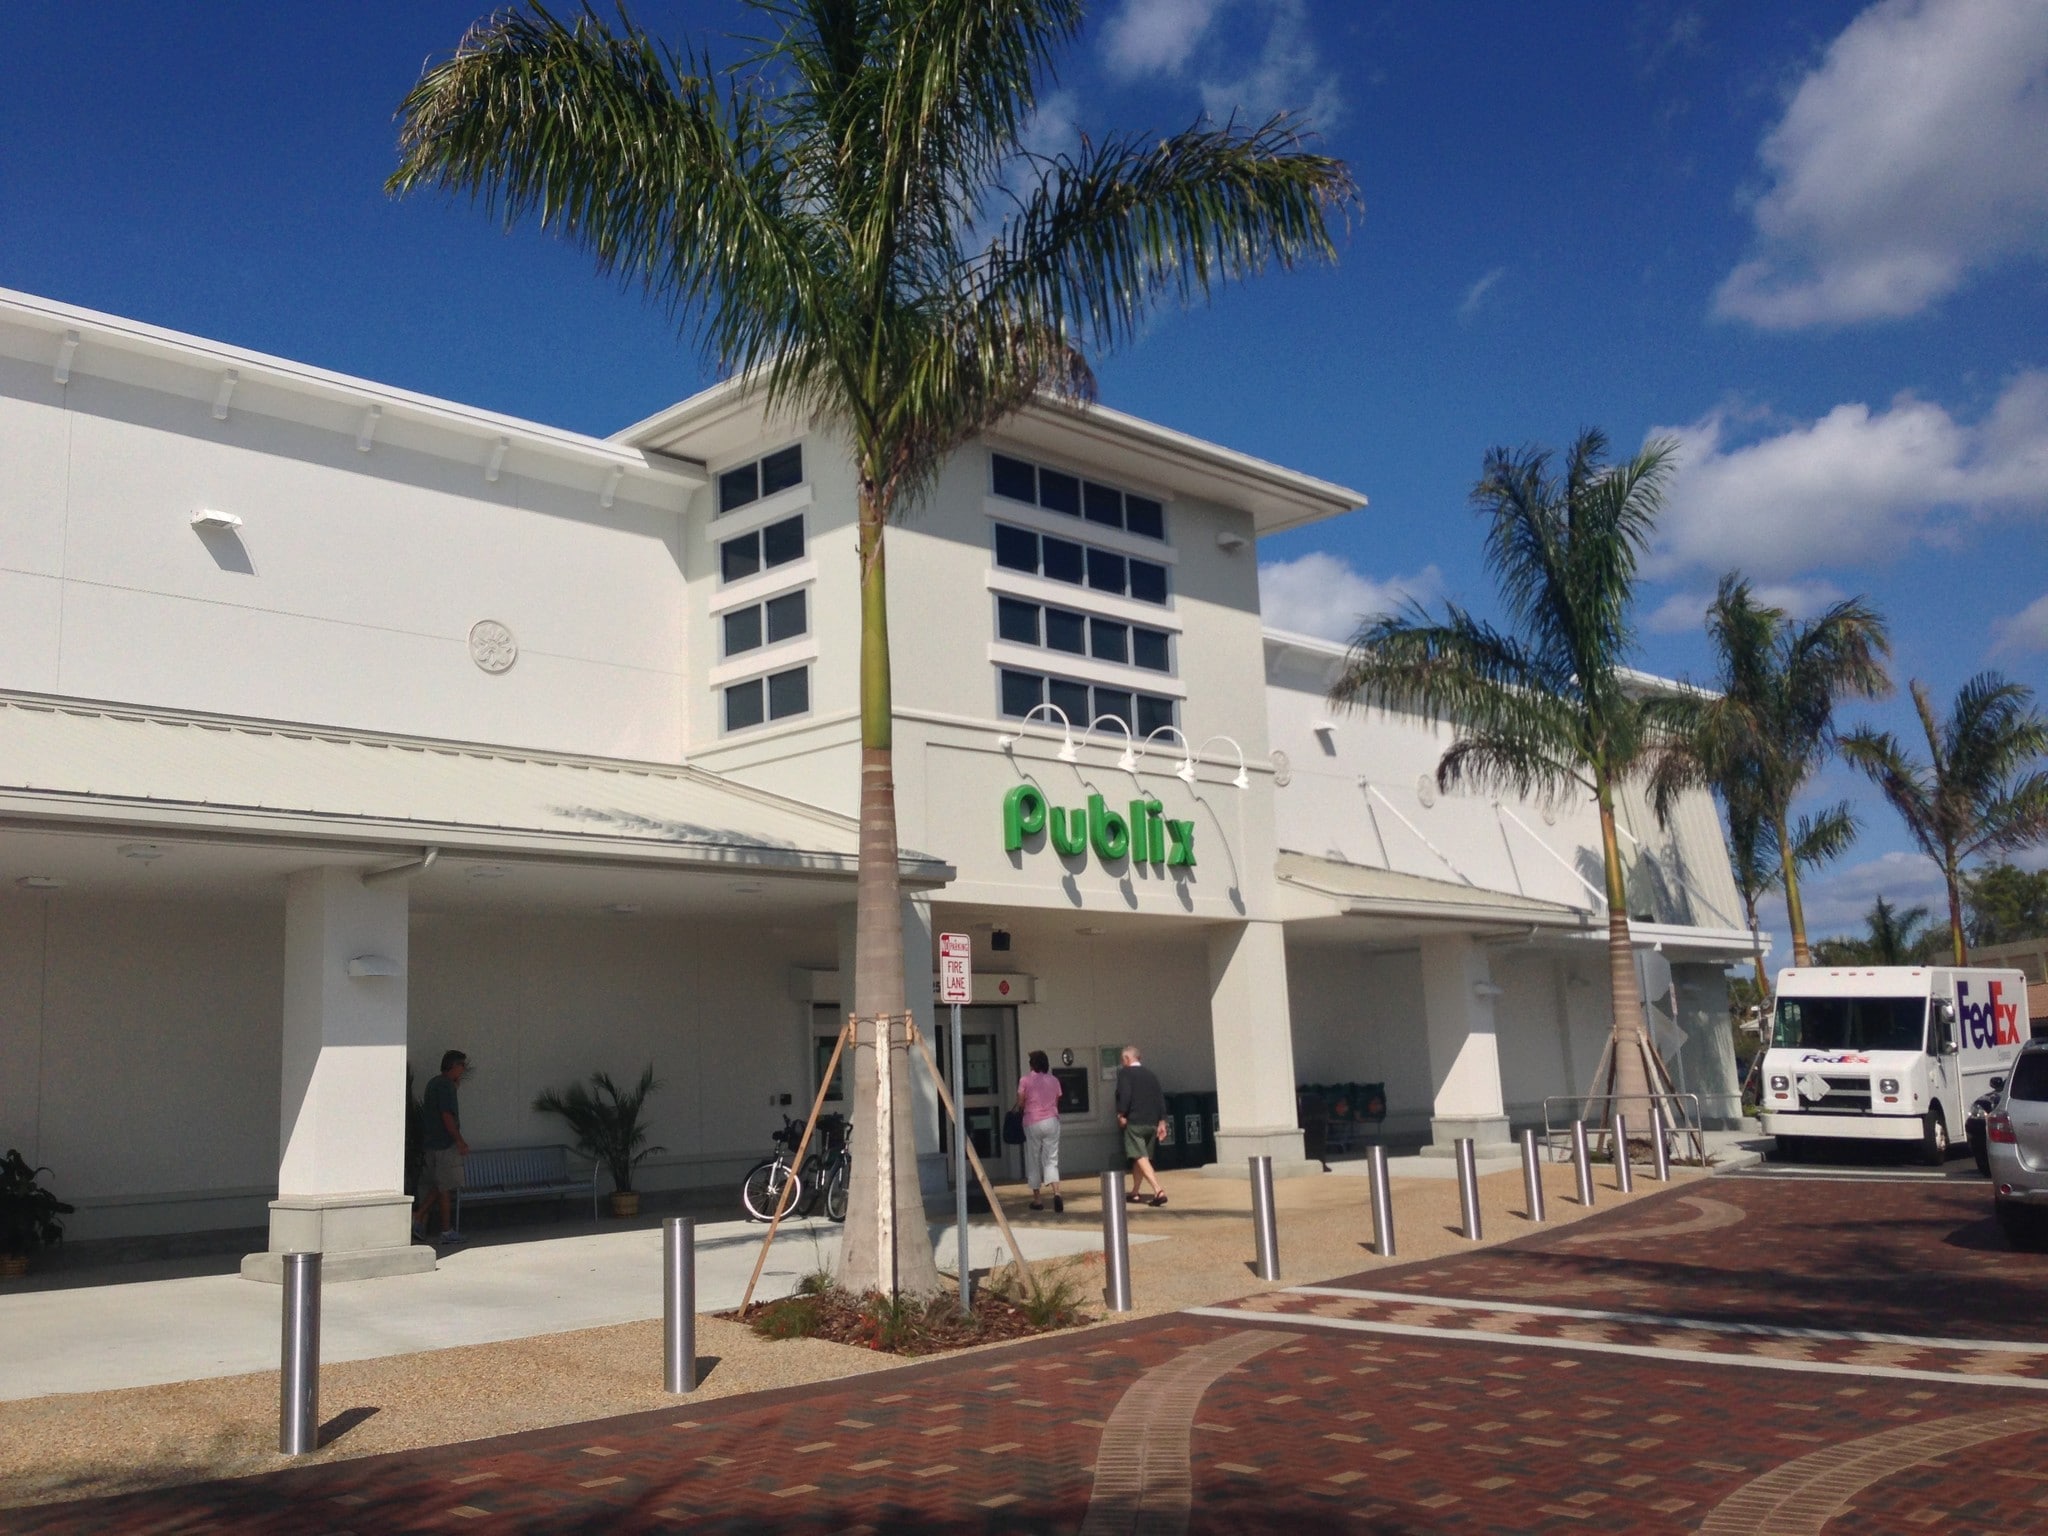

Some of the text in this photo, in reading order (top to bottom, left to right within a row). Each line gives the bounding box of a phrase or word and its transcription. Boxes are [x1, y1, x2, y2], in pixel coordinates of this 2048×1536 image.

[1003, 784, 1197, 866] Publix
[947, 961, 963, 973] FIRE
[946, 977, 965, 989] LANE
[1957, 981, 2020, 1049] FedEx
[1802, 1055, 1869, 1063] FedEx
